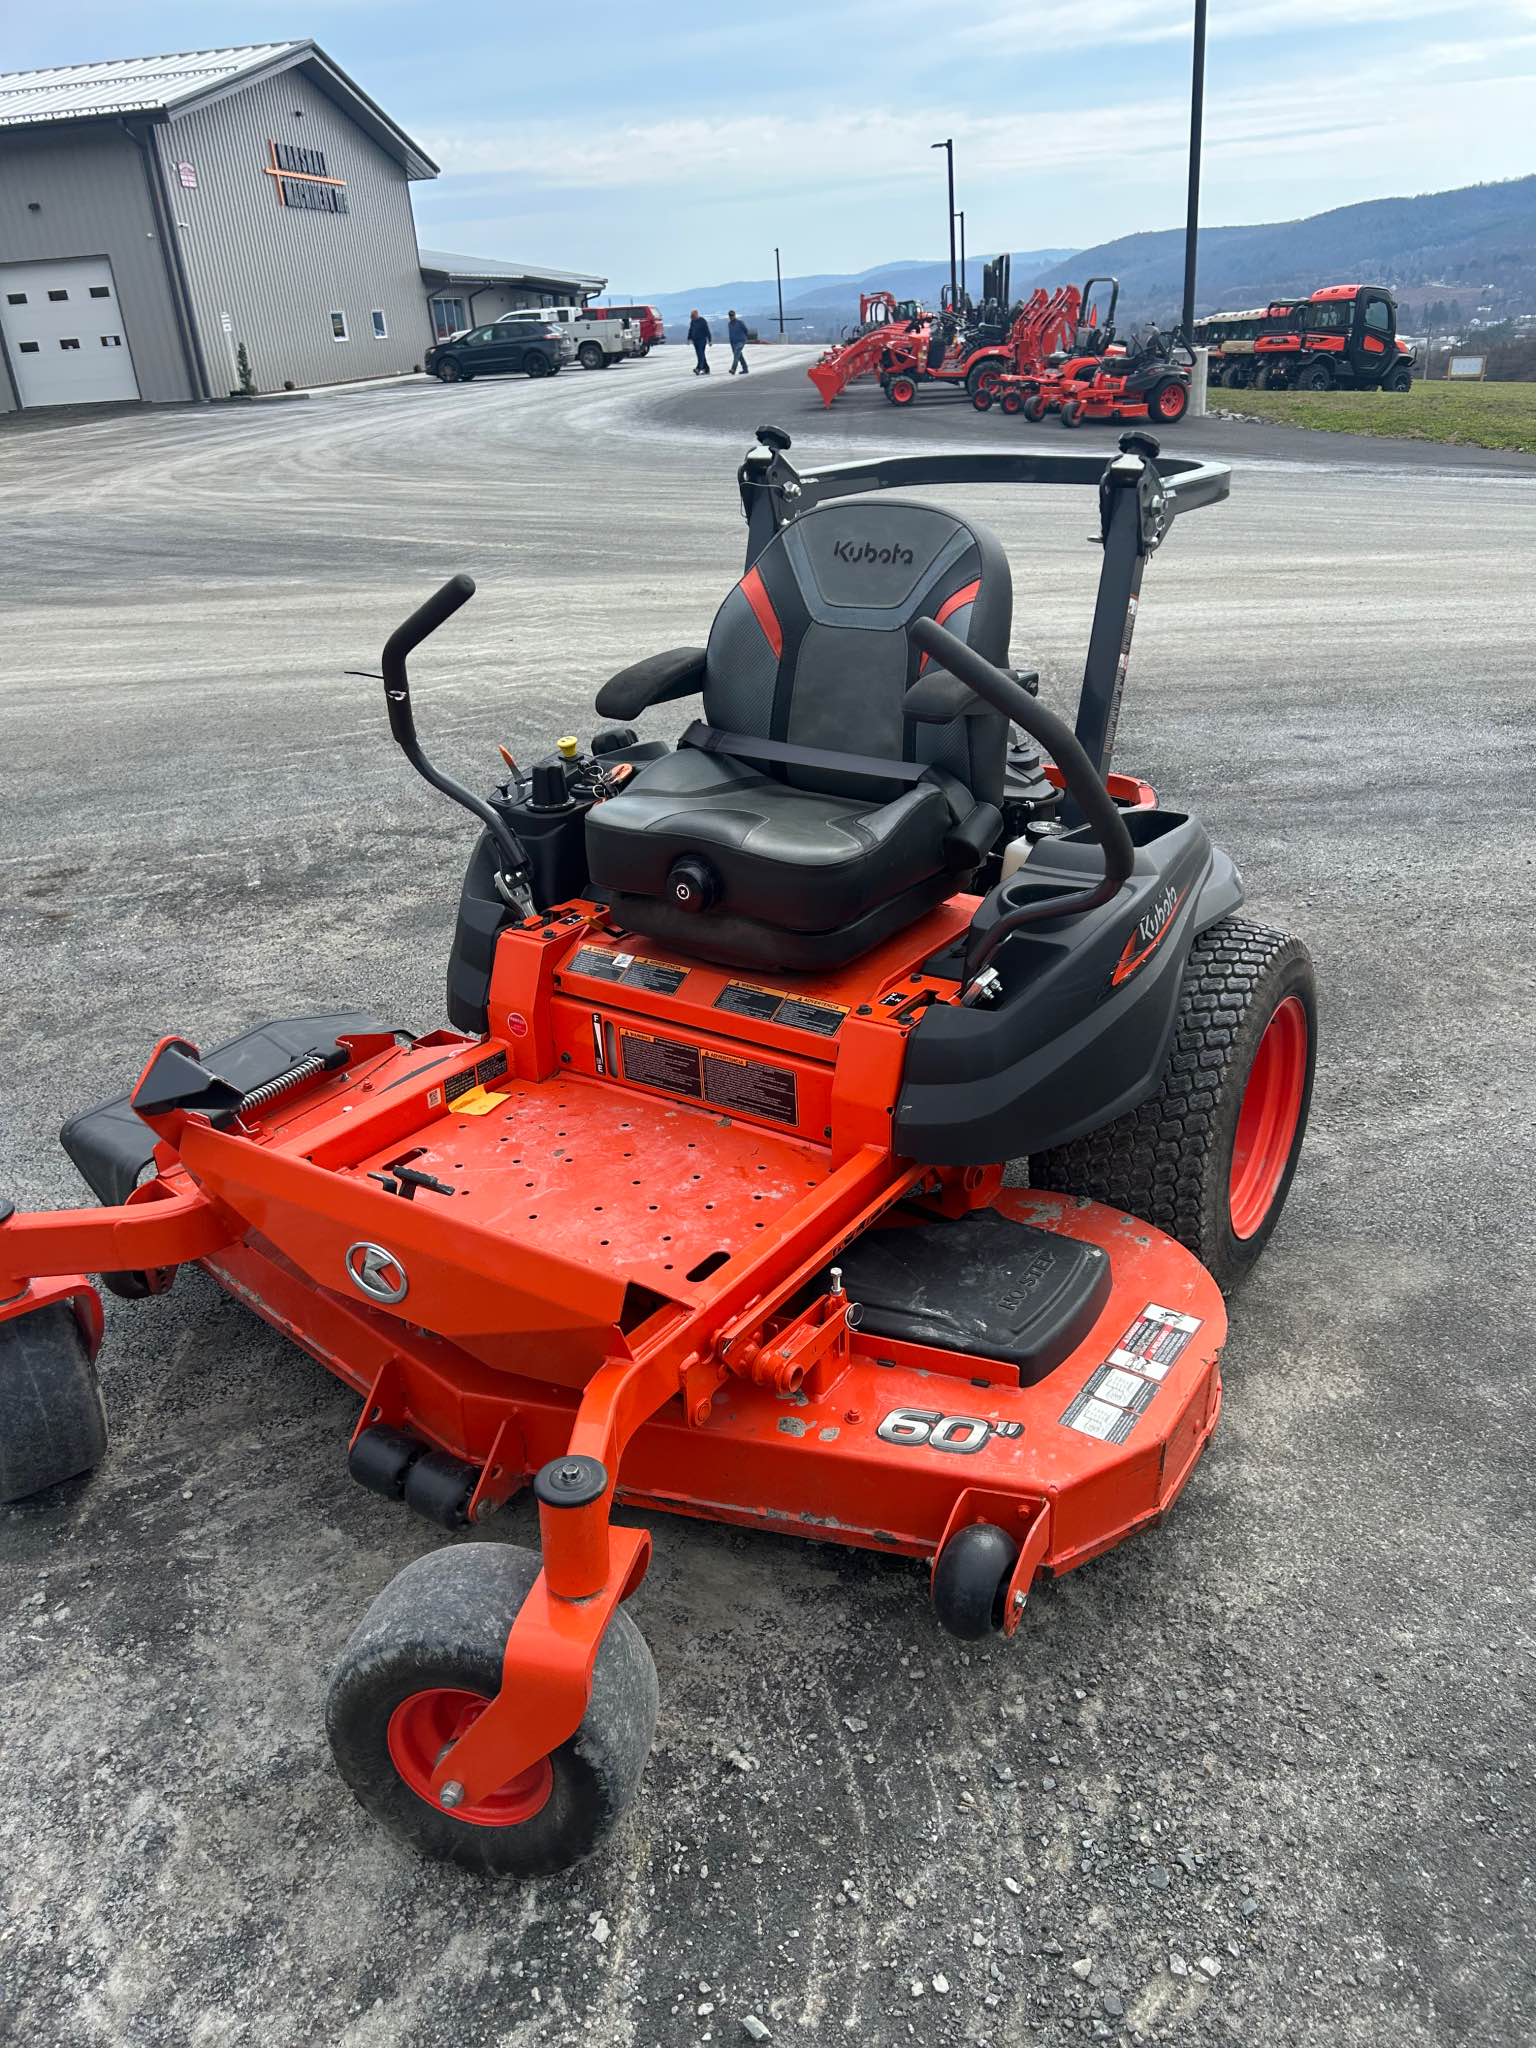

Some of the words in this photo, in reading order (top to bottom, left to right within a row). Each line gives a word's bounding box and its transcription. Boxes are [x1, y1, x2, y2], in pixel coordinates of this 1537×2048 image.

[834, 540, 914, 565] Kubota
[1139, 886, 1178, 941] Kubota
[593, 1014, 599, 1022] F
[597, 1064, 604, 1073] E
[998, 1288, 1027, 1311] NO
